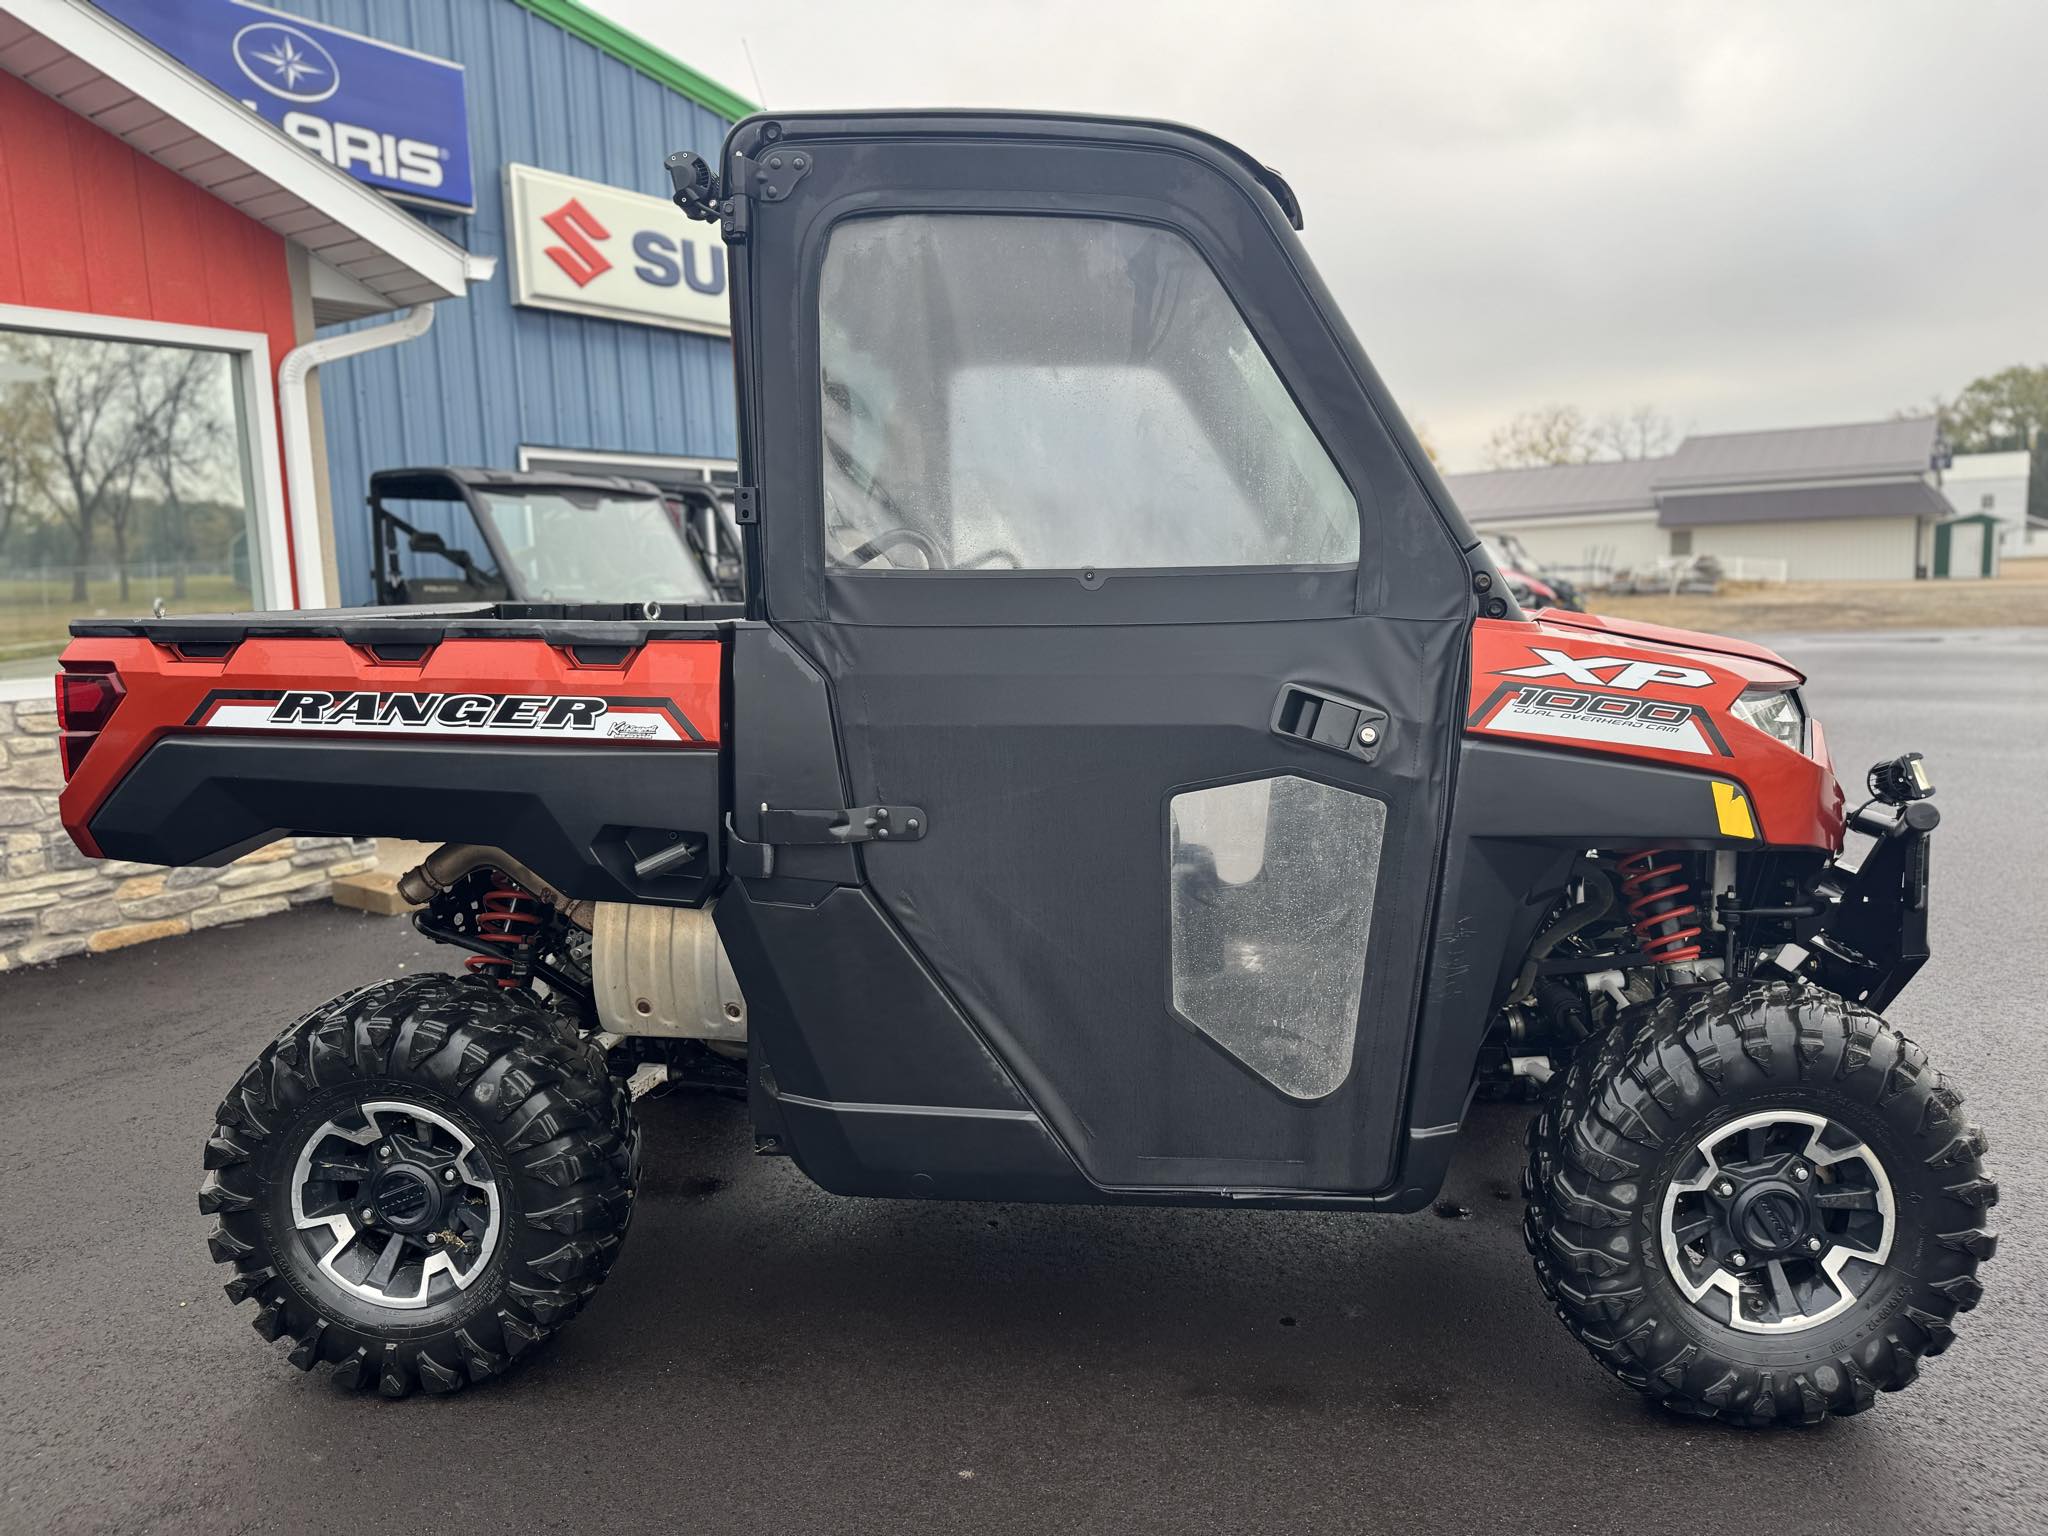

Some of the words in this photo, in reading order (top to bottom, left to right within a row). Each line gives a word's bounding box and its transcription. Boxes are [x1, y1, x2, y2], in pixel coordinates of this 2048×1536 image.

[241, 99, 443, 187] ARIS
[1484, 646, 1717, 691] XP
[269, 690, 607, 731] RANGER
[1512, 686, 1693, 727] 1000
[1513, 707, 1556, 718] DUAL
[1560, 712, 1644, 729] OVERHEAD
[1645, 723, 1680, 734] CAM
